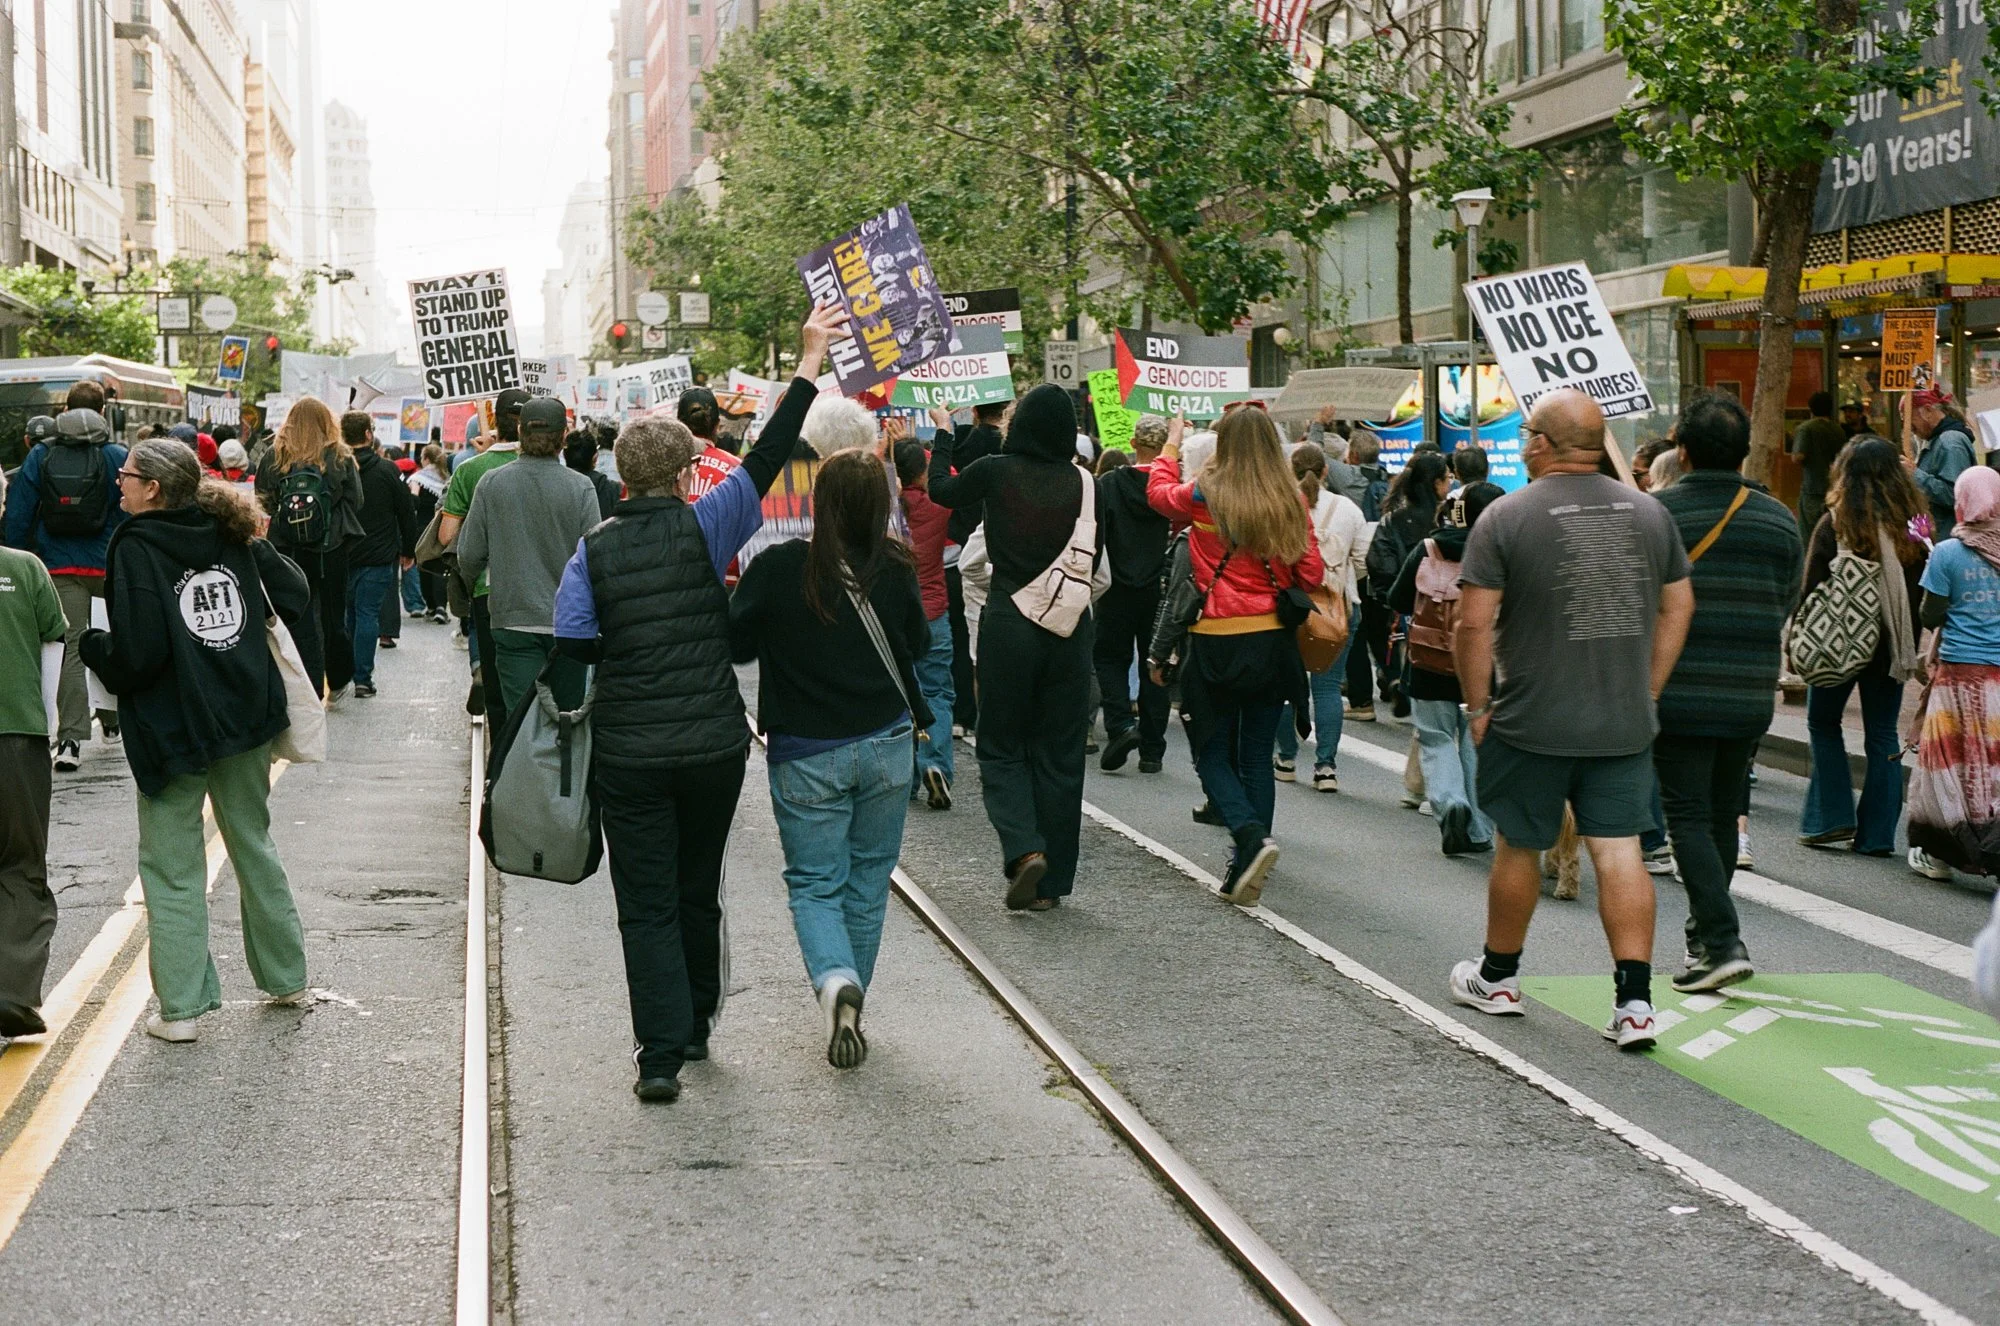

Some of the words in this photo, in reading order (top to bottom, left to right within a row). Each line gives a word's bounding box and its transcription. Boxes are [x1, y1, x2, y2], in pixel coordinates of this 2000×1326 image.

[1832, 143, 1877, 190] 150
[1886, 117, 1972, 176] Years!
[413, 274, 479, 294] MAY
[485, 272, 502, 285] 1:
[804, 262, 840, 308] CUT
[833, 234, 884, 318] CARE!
[415, 291, 478, 317] STAND
[481, 288, 505, 309] UP
[1478, 282, 1515, 314] NO
[1514, 268, 1588, 305] WARS
[942, 297, 969, 313] END
[417, 317, 442, 336] TO
[444, 309, 509, 334] TRUMP
[1496, 311, 1548, 353] NO
[1546, 300, 1603, 343] ICE
[421, 329, 515, 368] GENERAL
[861, 317, 902, 373] WE
[1048, 344, 1077, 352] SPEED
[1146, 336, 1181, 360] END
[522, 362, 547, 374] RKERS
[908, 357, 990, 379] GENOCIDE
[1052, 364, 1073, 379] 10
[1532, 347, 1599, 384] NO
[1885, 353, 1917, 366] MUST
[426, 357, 520, 400] STRIKE!
[524, 374, 540, 385] VER
[1147, 365, 1228, 389] GENOCIDE
[1884, 369, 1911, 388] GO!
[911, 385, 930, 405] IN
[931, 383, 981, 406] GAZA
[1147, 392, 1165, 412] IN
[1167, 395, 1215, 415] GAZA
[1521, 371, 1642, 412] BNAIRES!
[192, 580, 231, 613] AFT
[195, 610, 235, 628] 2121
